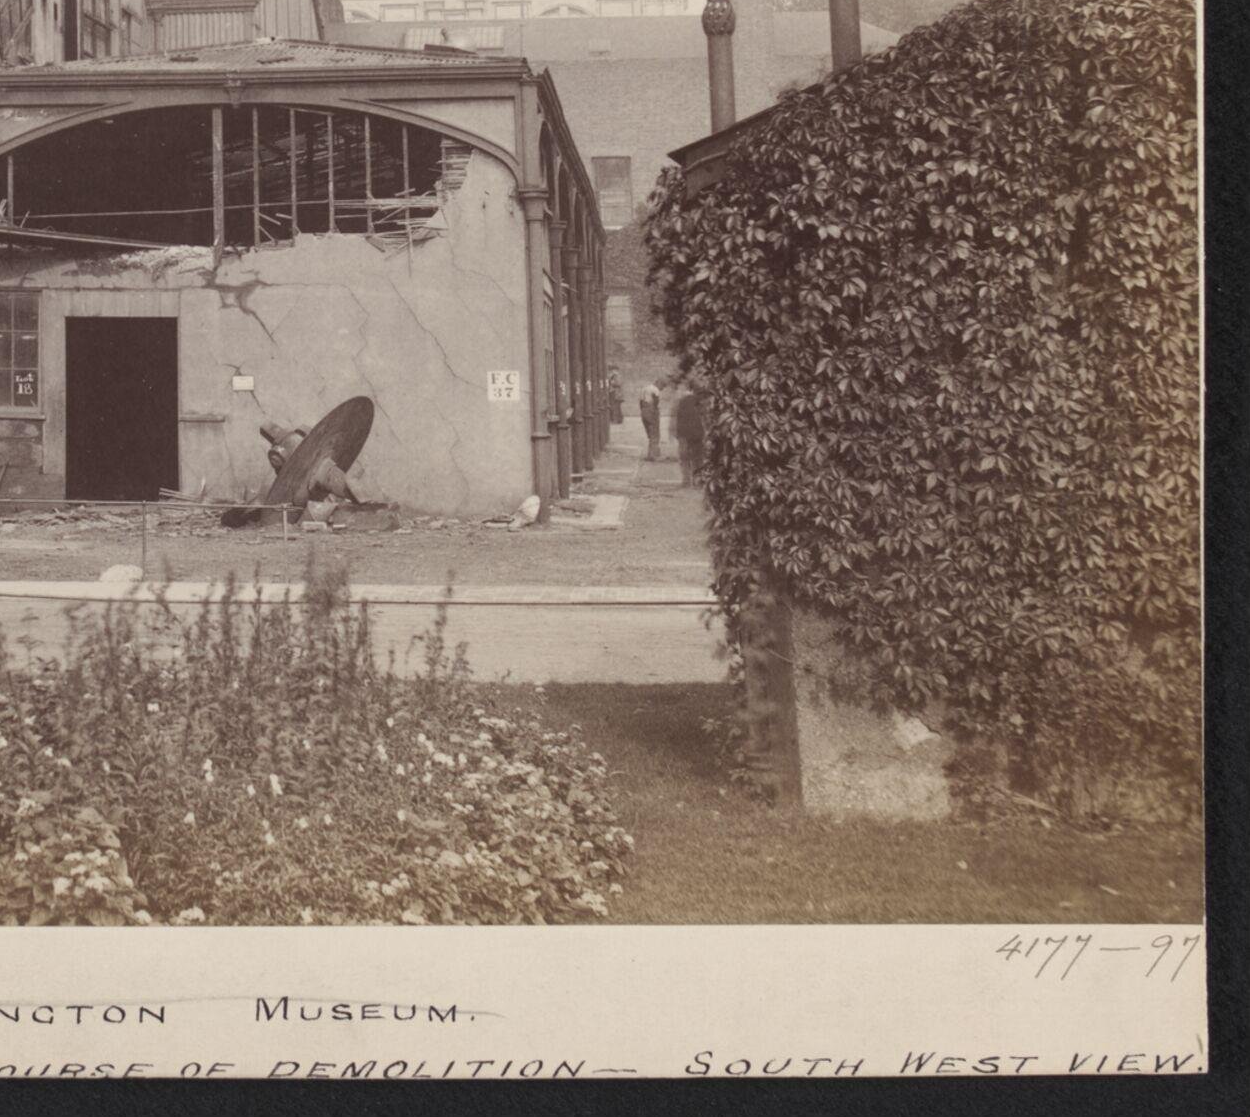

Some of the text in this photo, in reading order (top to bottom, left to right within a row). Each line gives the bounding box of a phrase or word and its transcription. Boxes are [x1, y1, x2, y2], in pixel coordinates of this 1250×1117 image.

[17, 383, 34, 395] 18
[255, 996, 476, 1023] MUSEUM.
[180, 1062, 236, 1079] OF
[684, 1050, 865, 1076] SOUTH
[900, 1051, 1039, 1074] WEST
[1068, 1052, 1203, 1074] VIEW.
